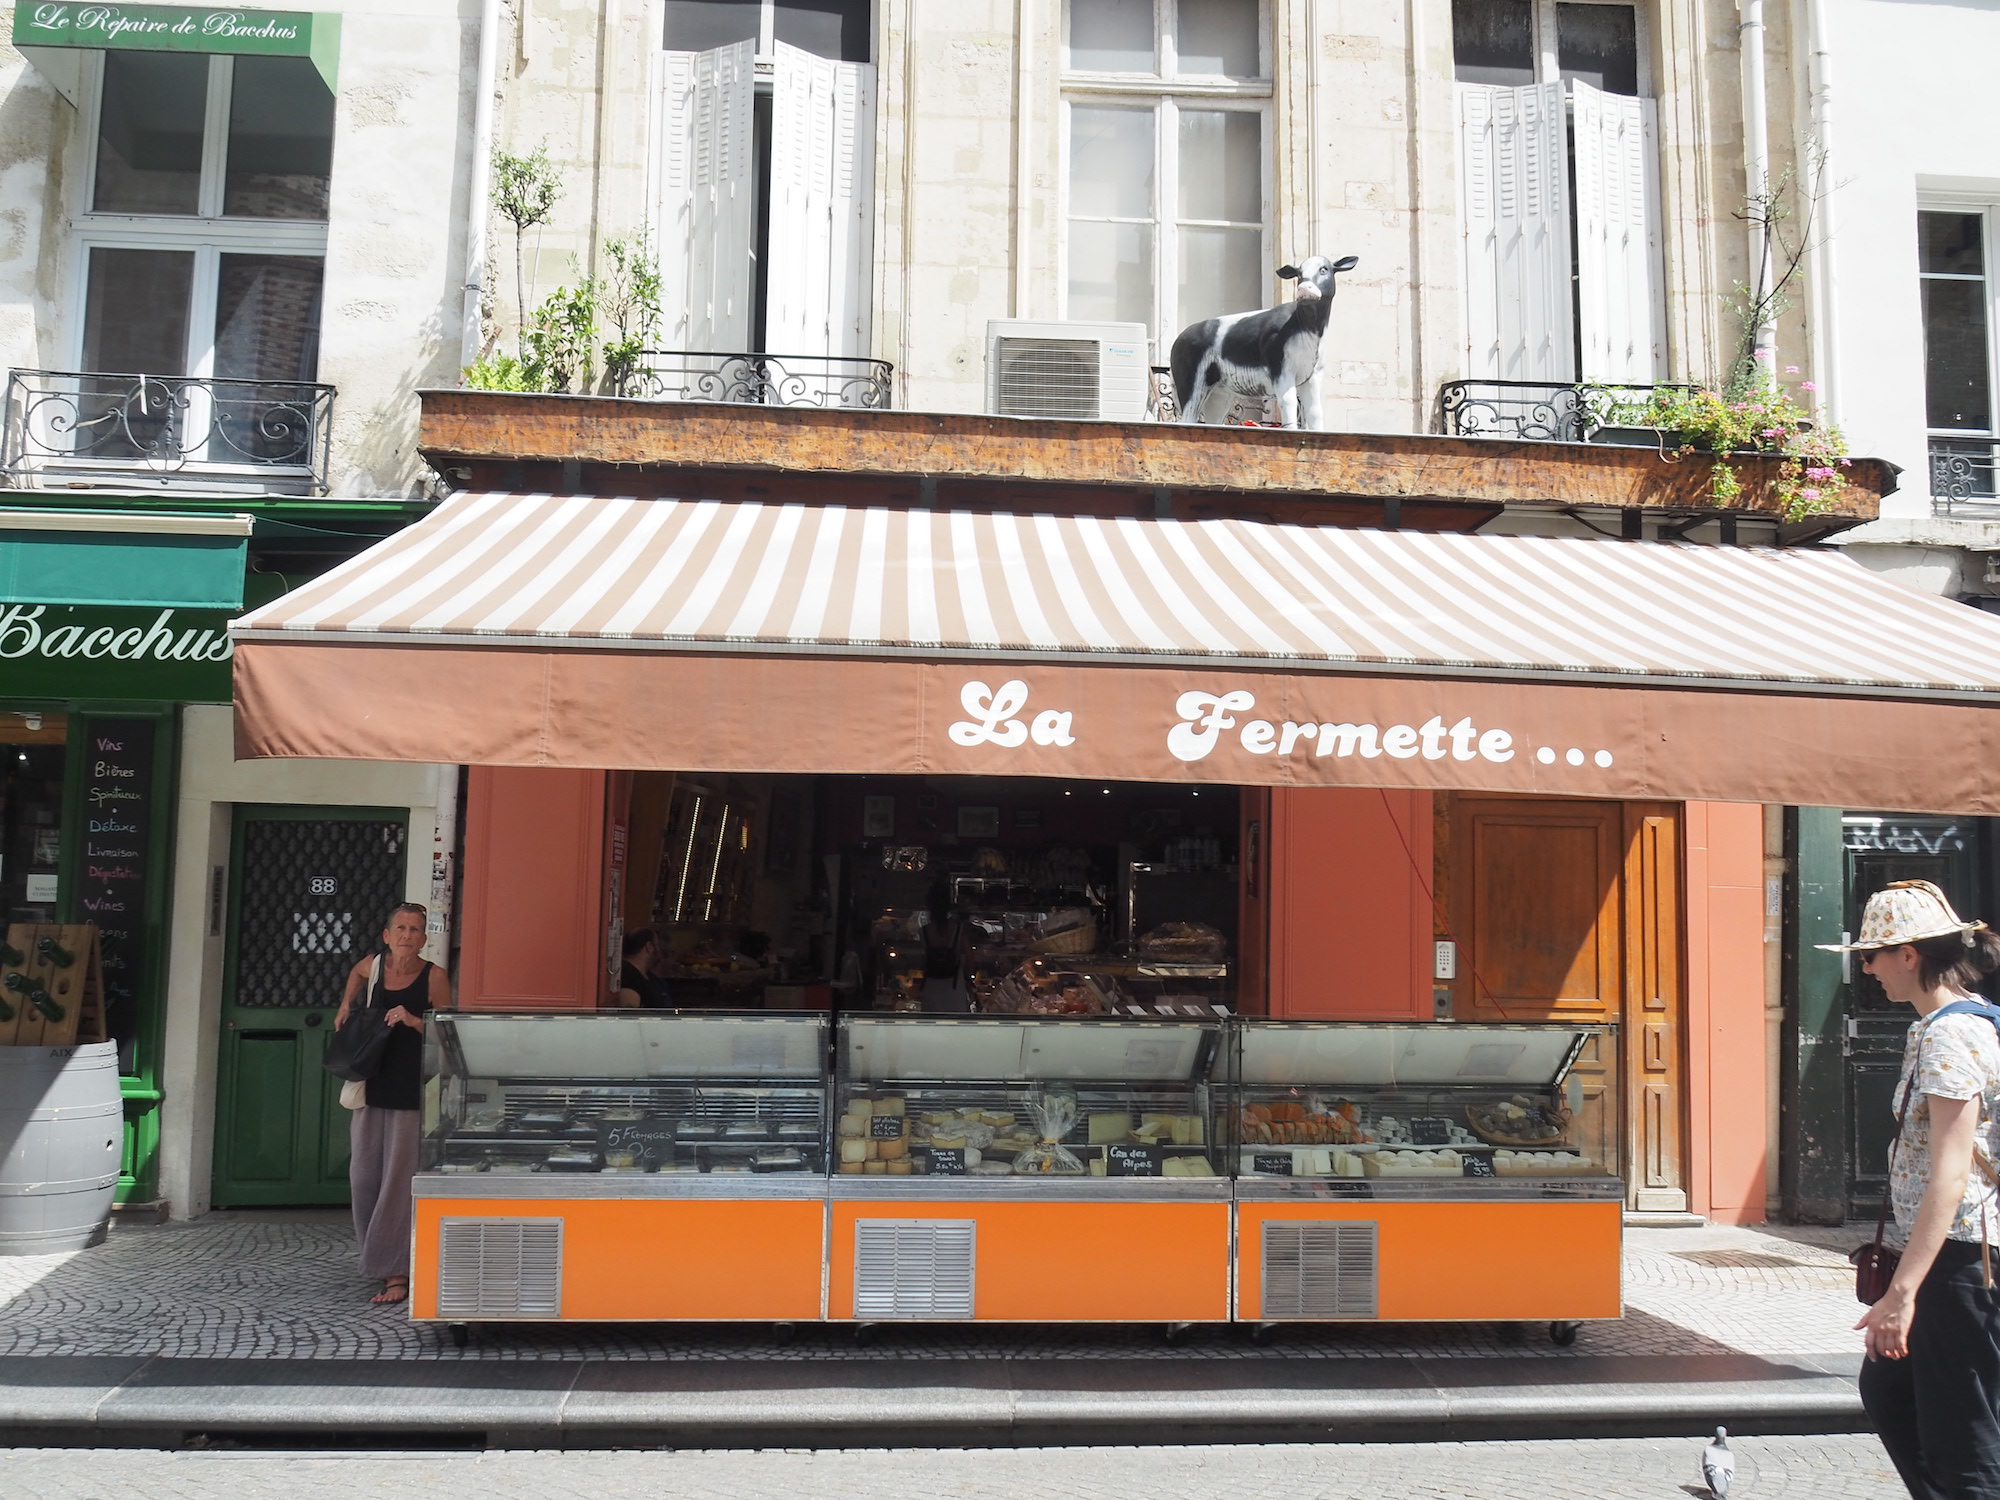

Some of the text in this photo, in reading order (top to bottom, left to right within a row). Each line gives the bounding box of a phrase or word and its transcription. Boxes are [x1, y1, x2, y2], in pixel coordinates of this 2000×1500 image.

[30, 4, 297, 39] Le Repaire de Bacchus
[0, 604, 235, 662] Bacchus
[947, 680, 1076, 748] La
[1166, 690, 1515, 762] Fermette
[97, 738, 124, 751] Vins
[95, 761, 135, 778] Bières
[89, 818, 139, 833] Détaxe
[311, 878, 335, 894] 88
[84, 897, 125, 912] Wines
[608, 1128, 622, 1147] 5
[1129, 1149, 1147, 1158] des
[1122, 1158, 1153, 1171] Alpes
